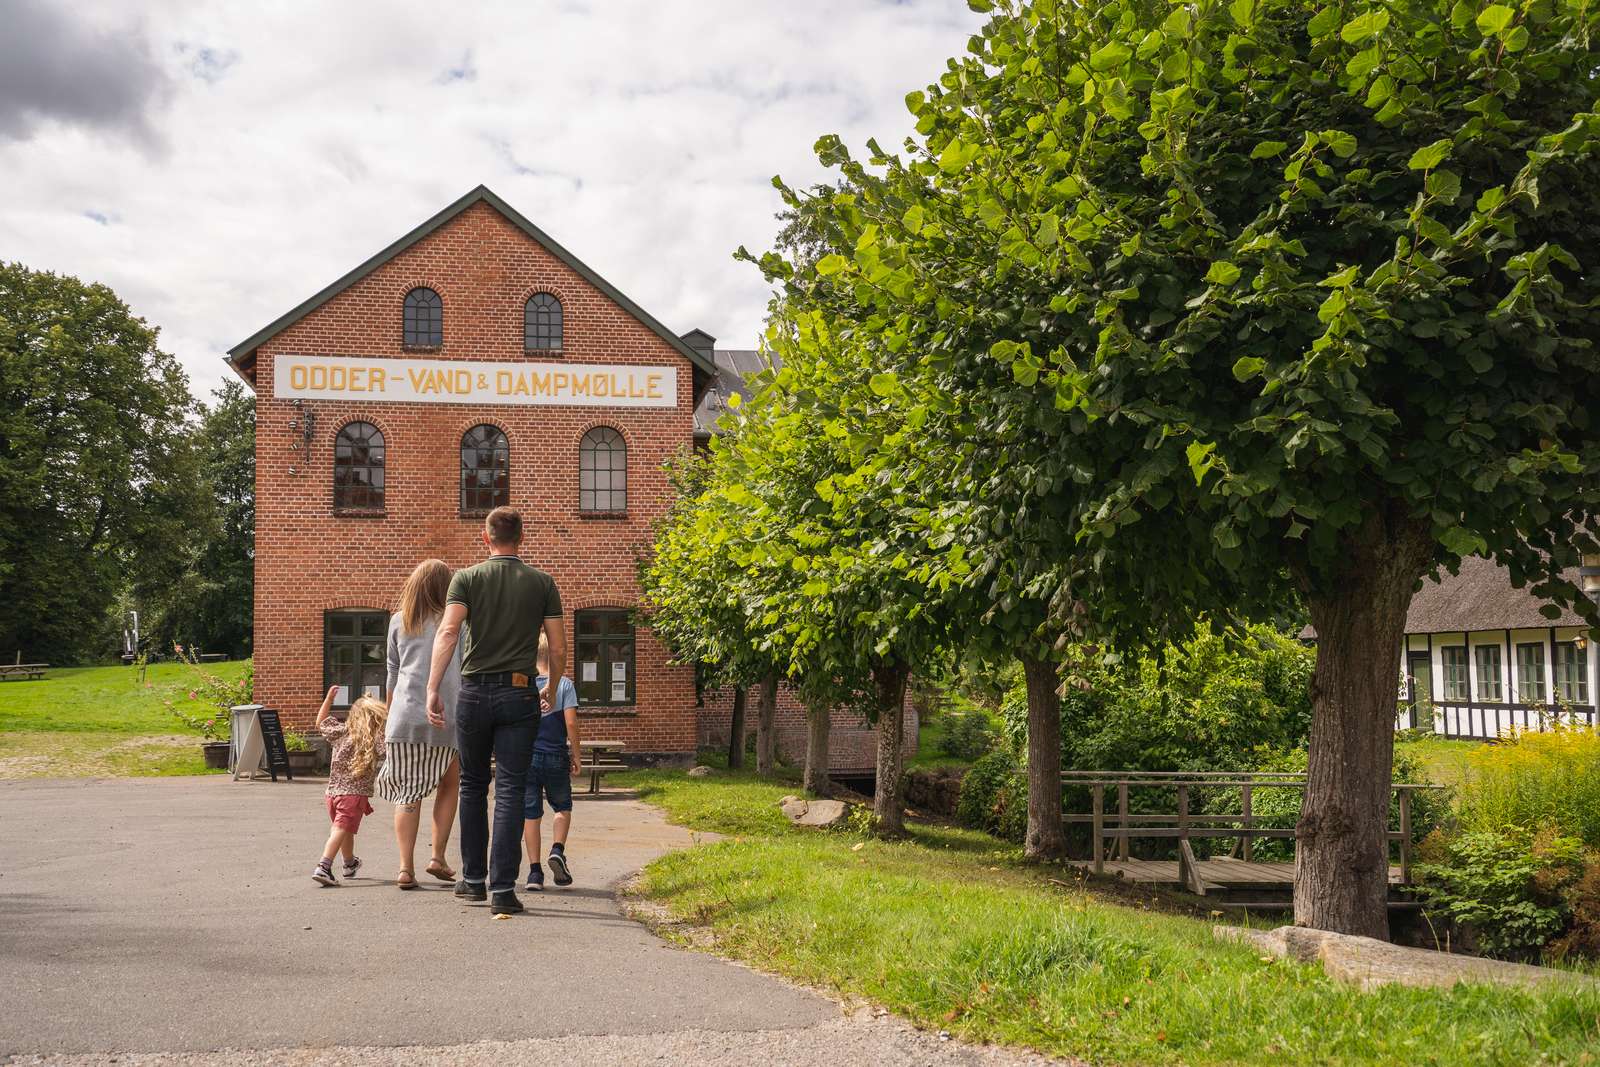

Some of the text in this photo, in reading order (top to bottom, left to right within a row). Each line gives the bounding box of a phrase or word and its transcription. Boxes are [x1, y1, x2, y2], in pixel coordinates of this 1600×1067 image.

[408, 368, 472, 394] VAND
[477, 373, 489, 390] &
[496, 370, 664, 398] DAMPMØLLE
